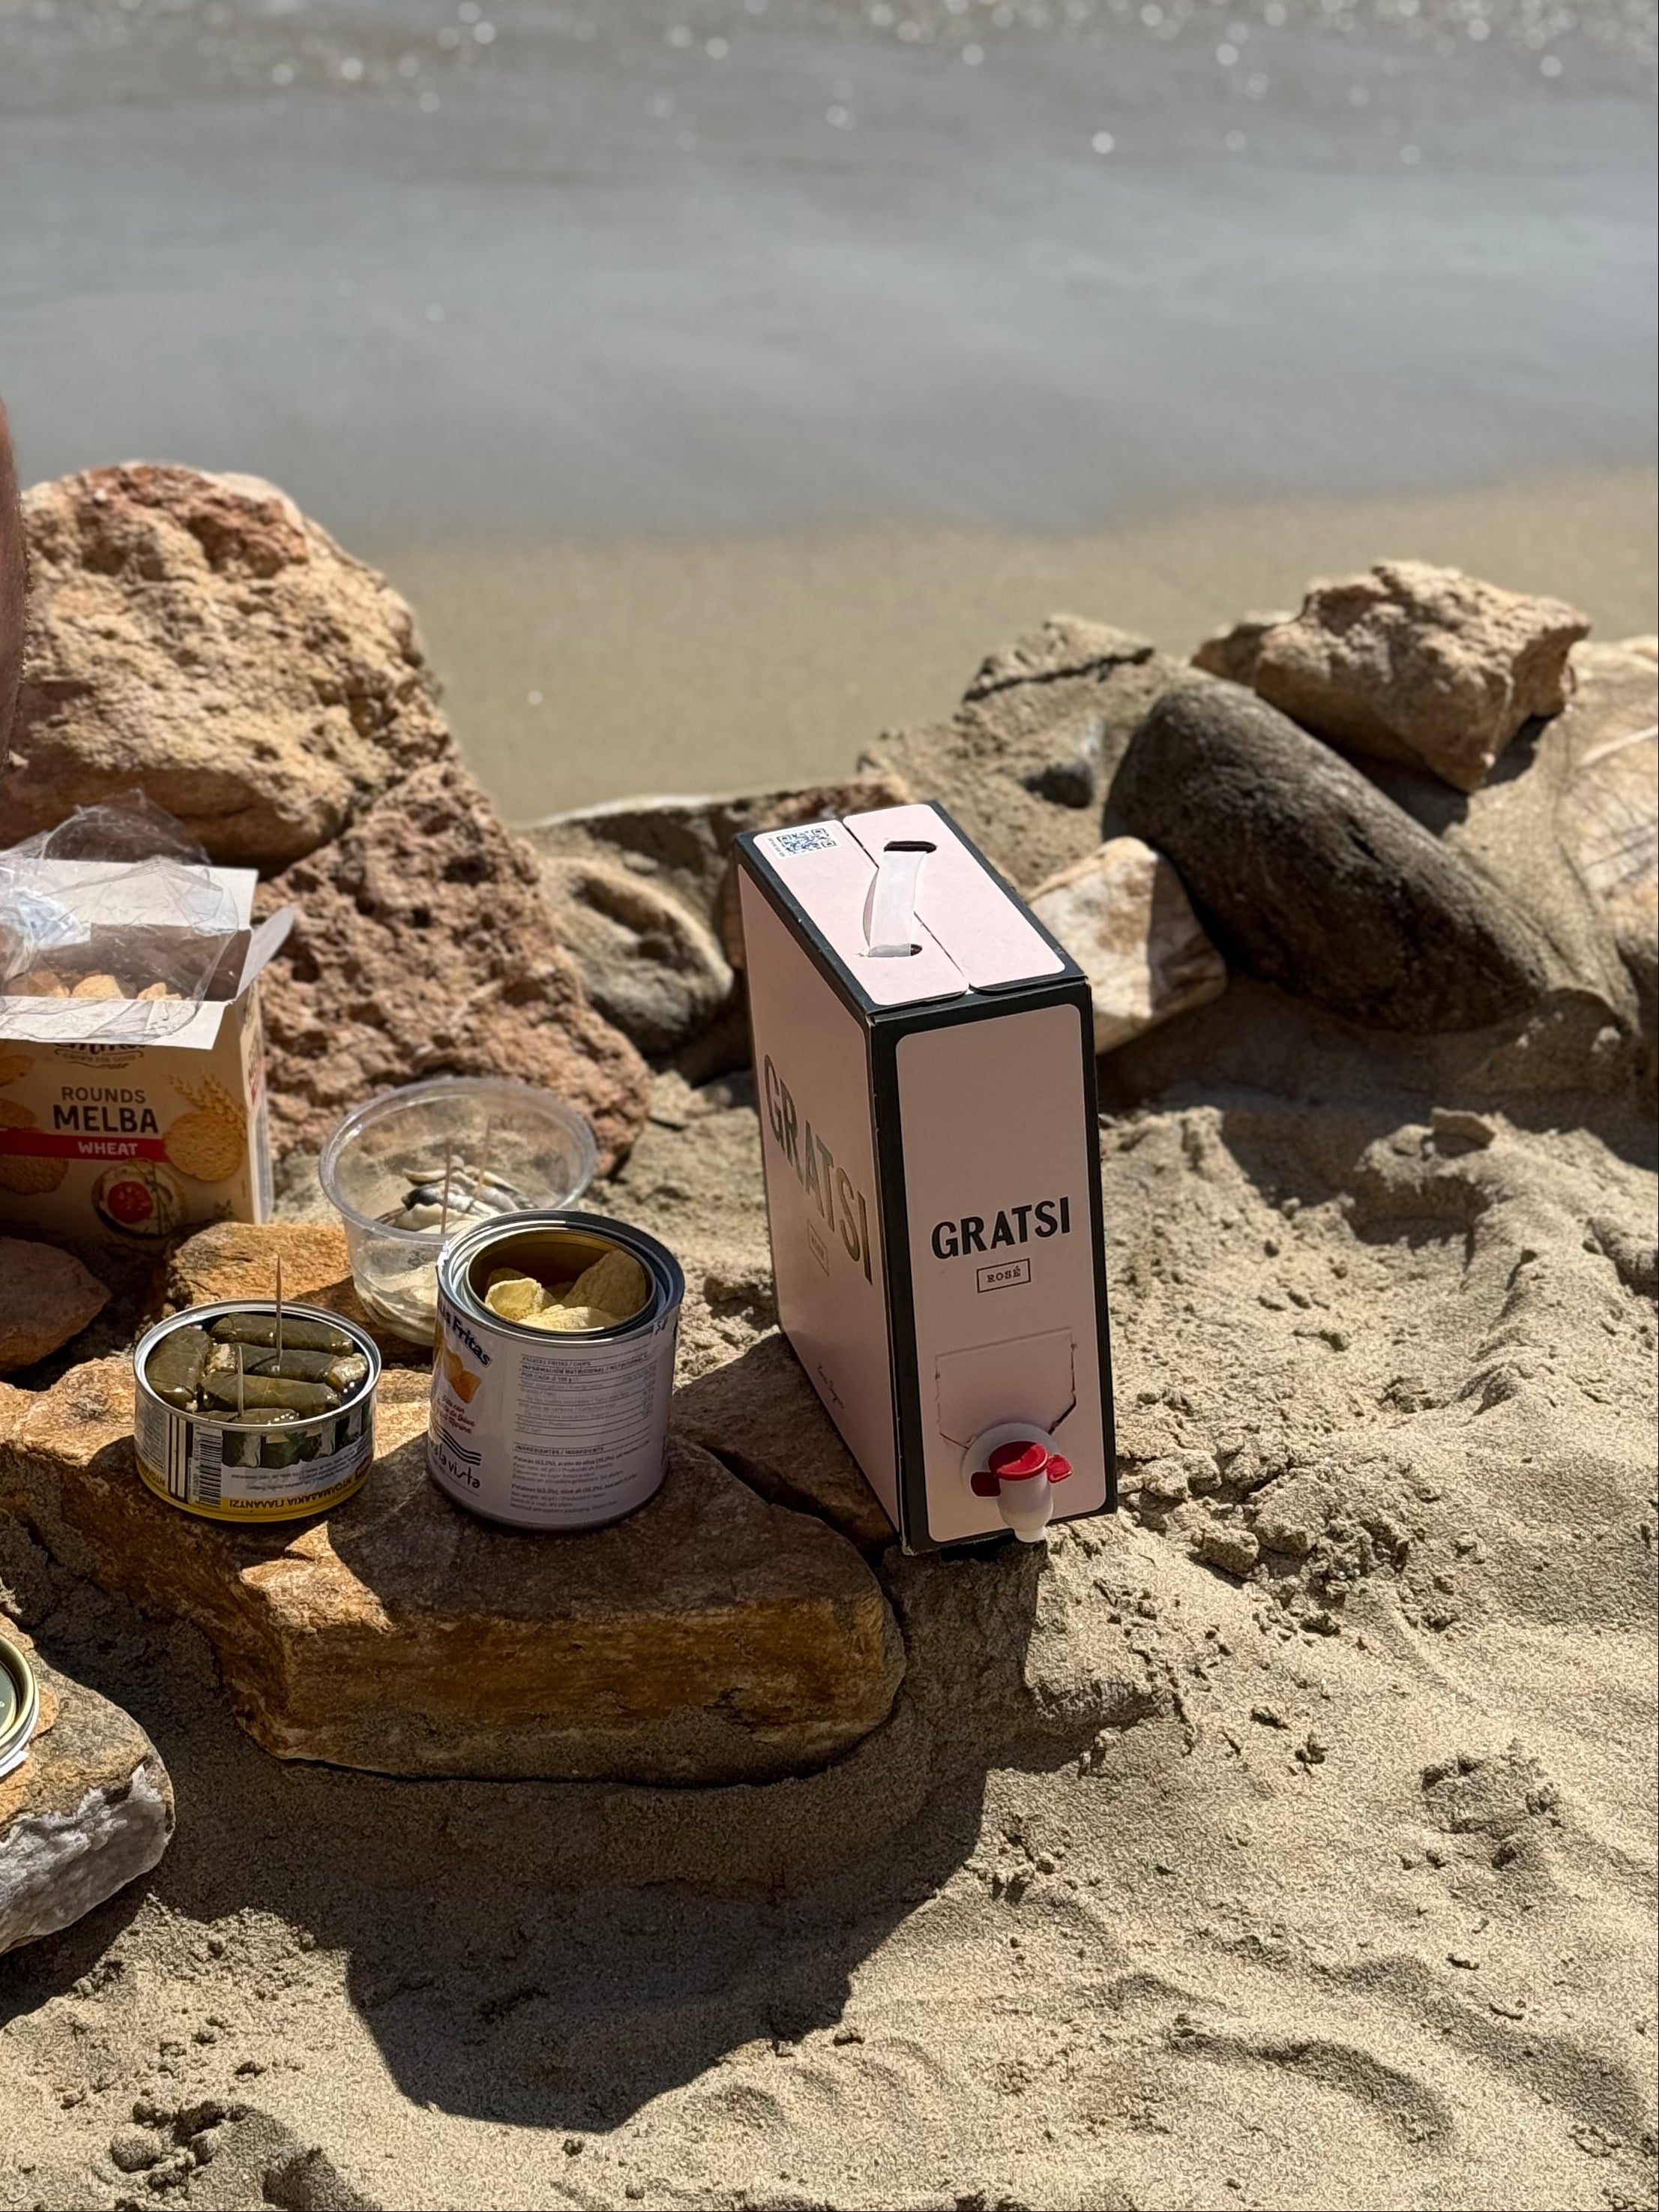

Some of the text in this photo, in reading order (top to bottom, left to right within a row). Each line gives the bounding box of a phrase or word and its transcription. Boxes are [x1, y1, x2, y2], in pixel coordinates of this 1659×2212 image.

[61, 1087, 145, 1104] ROUNDS
[52, 1105, 158, 1134] MELBA
[77, 1140, 138, 1157] WHEAT
[765, 1054, 872, 1285] GRATSI
[932, 1197, 1072, 1260] GRATSI
[987, 1264, 1023, 1286] ROSÉ
[453, 1316, 490, 1365] Fritas
[448, 1461, 480, 1488] vista
